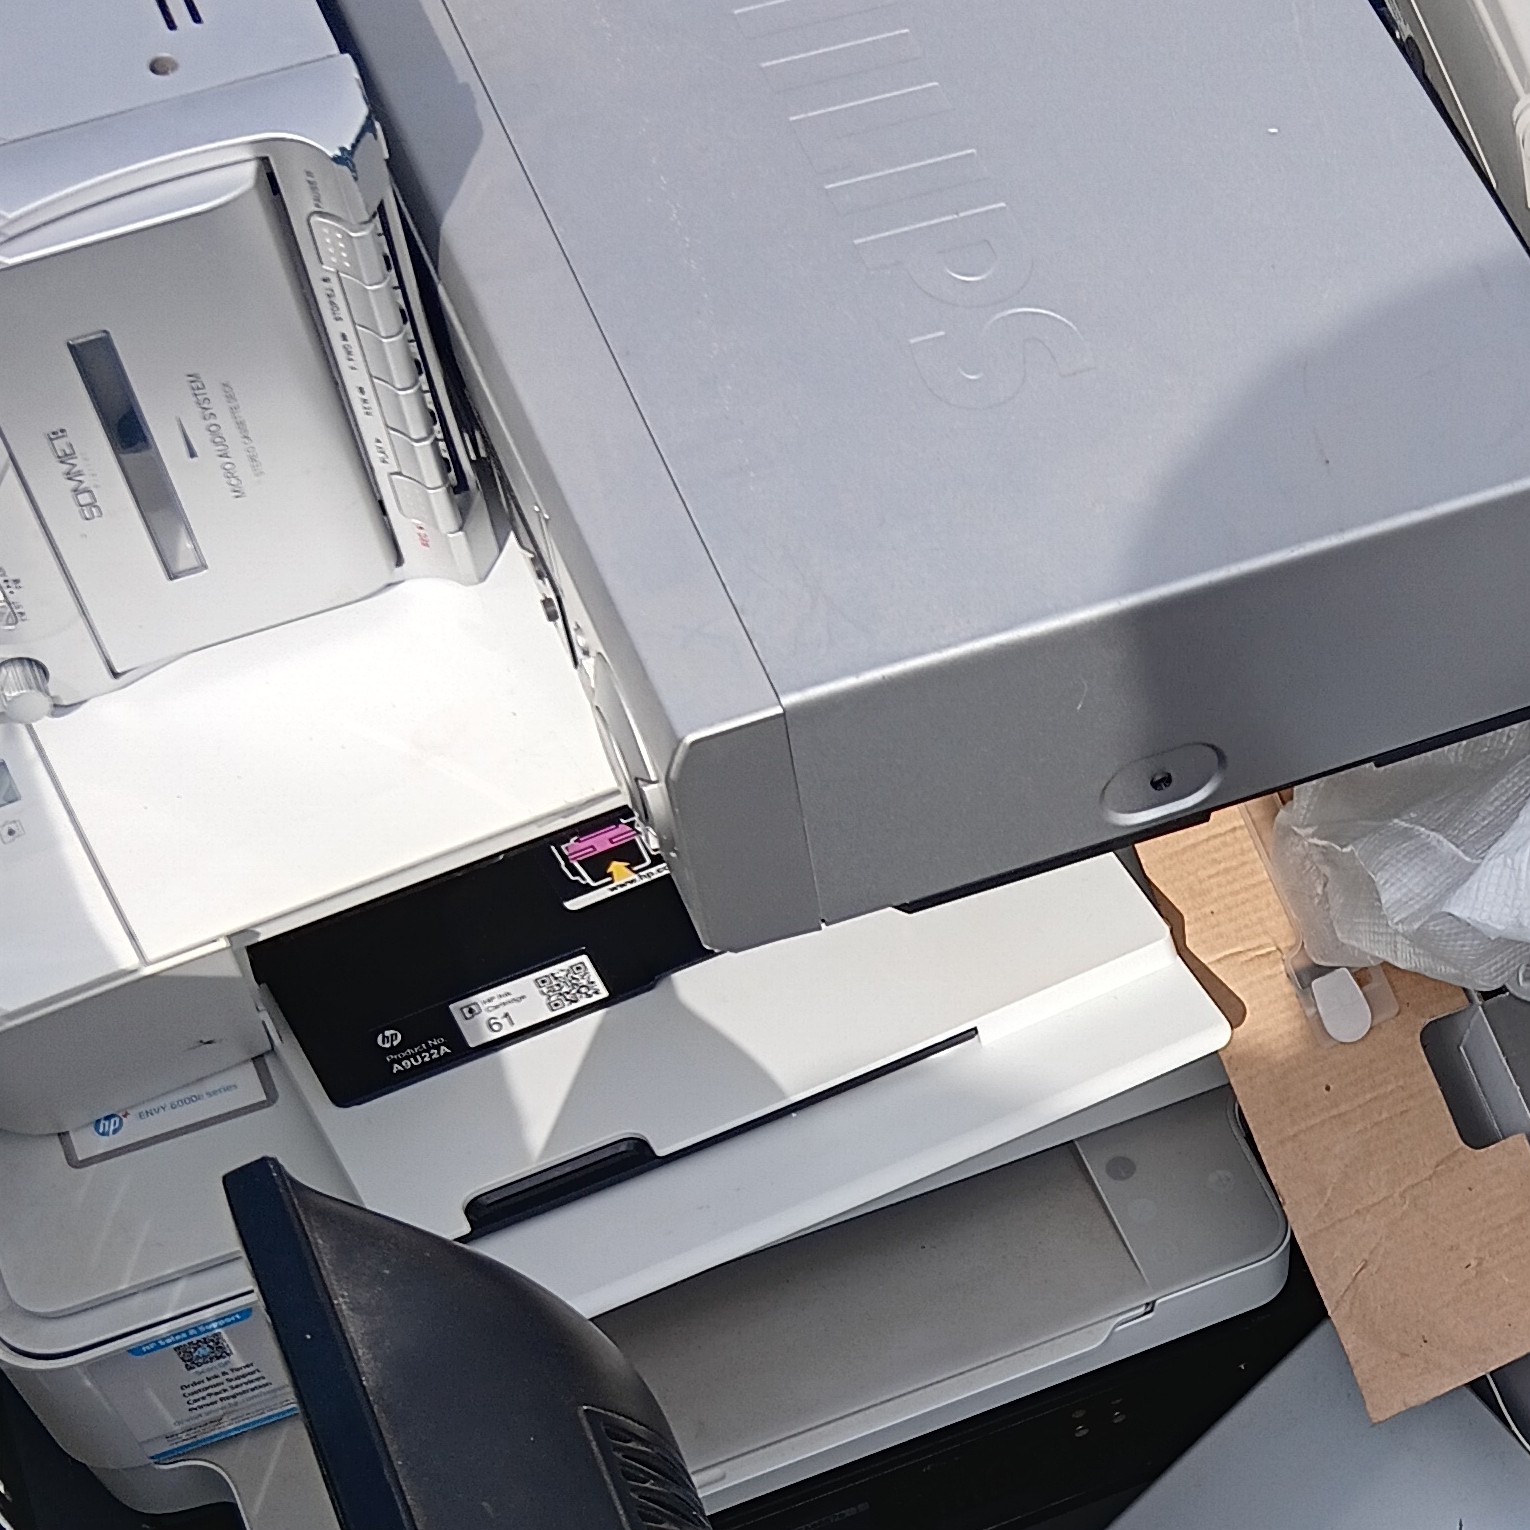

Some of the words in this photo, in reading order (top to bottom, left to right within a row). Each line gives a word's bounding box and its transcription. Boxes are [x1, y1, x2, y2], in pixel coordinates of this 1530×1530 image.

[185, 372, 217, 422] SYSTEM
[204, 422, 231, 459] AUDIO
[219, 457, 246, 499] MICRO
[376, 1029, 402, 1049] hp
[486, 1011, 515, 1034] 61
[385, 1042, 428, 1062] Product
[391, 1044, 452, 1074] A9U22A
[138, 1103, 168, 1120] ENVY
[205, 1083, 239, 1099] series
